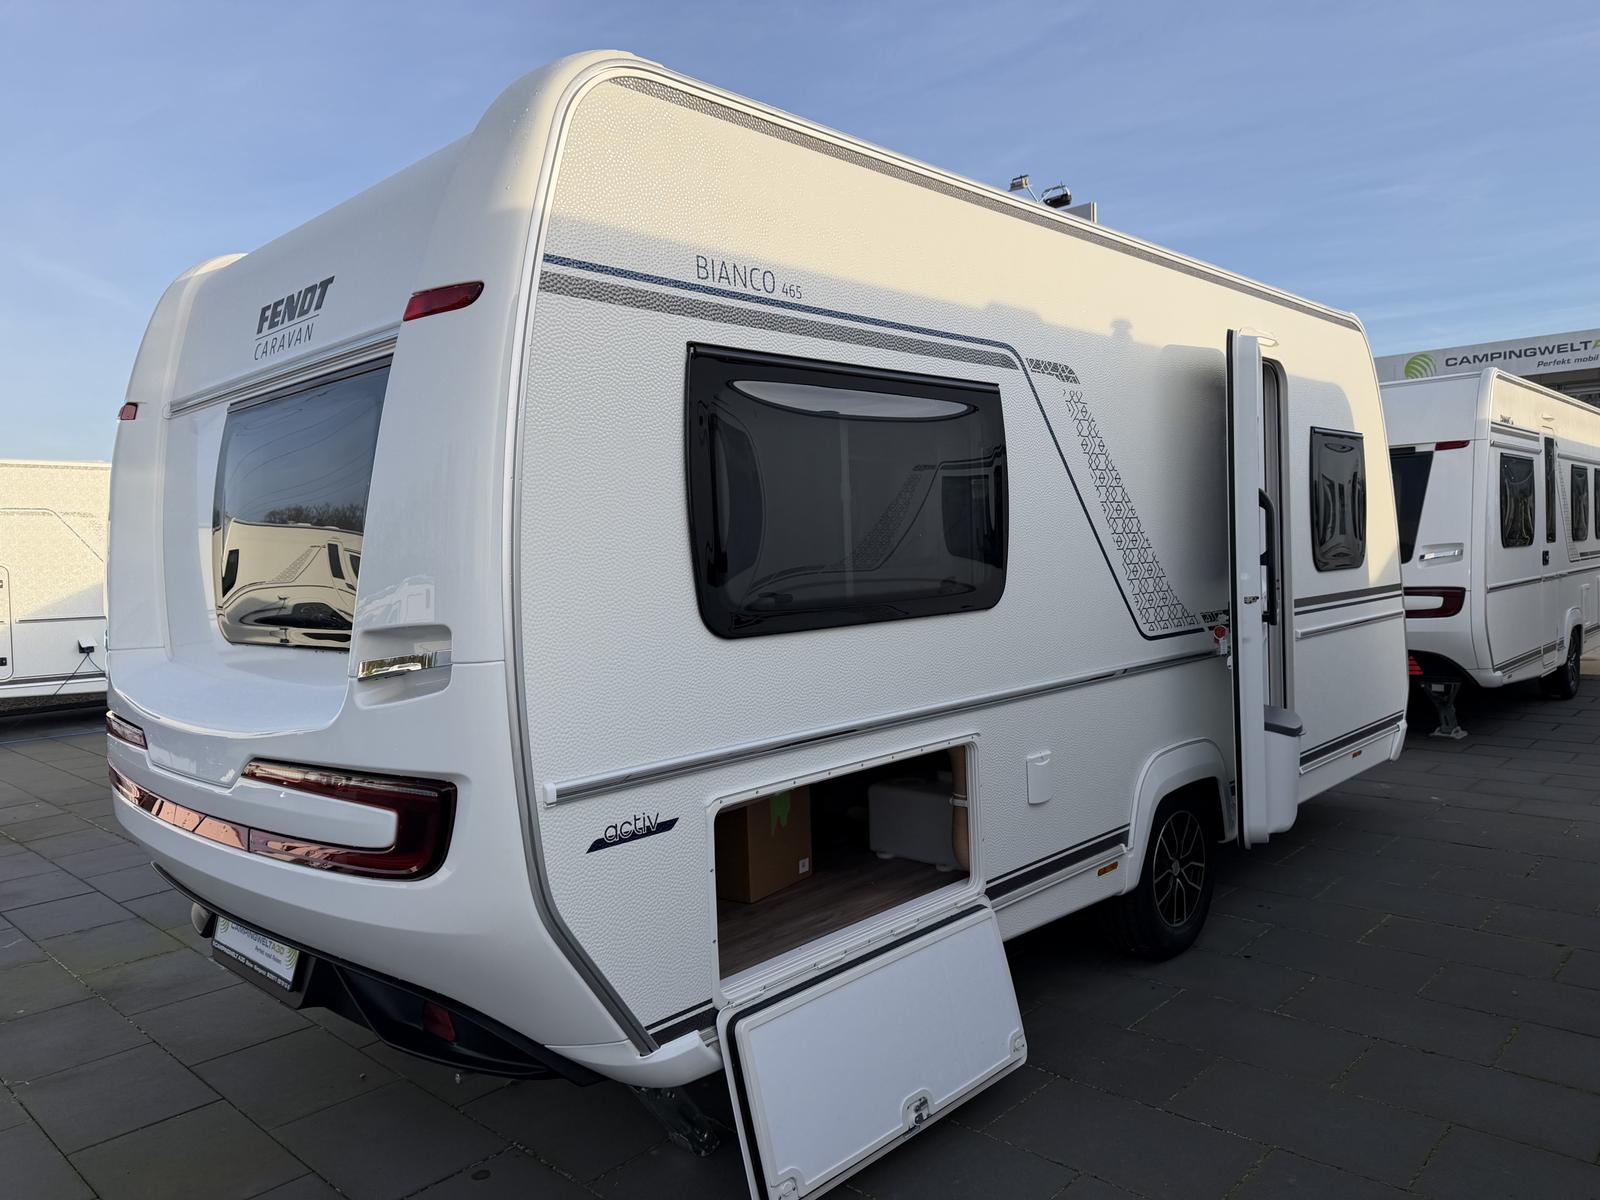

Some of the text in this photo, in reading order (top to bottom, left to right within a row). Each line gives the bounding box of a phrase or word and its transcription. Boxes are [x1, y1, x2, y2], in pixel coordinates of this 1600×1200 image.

[696, 254, 802, 300] BIANCO 465
[256, 275, 336, 335] FENDT
[254, 322, 314, 361] CARAVAN
[1537, 354, 1599, 368] Perfekt mobil
[604, 812, 660, 843] activ
